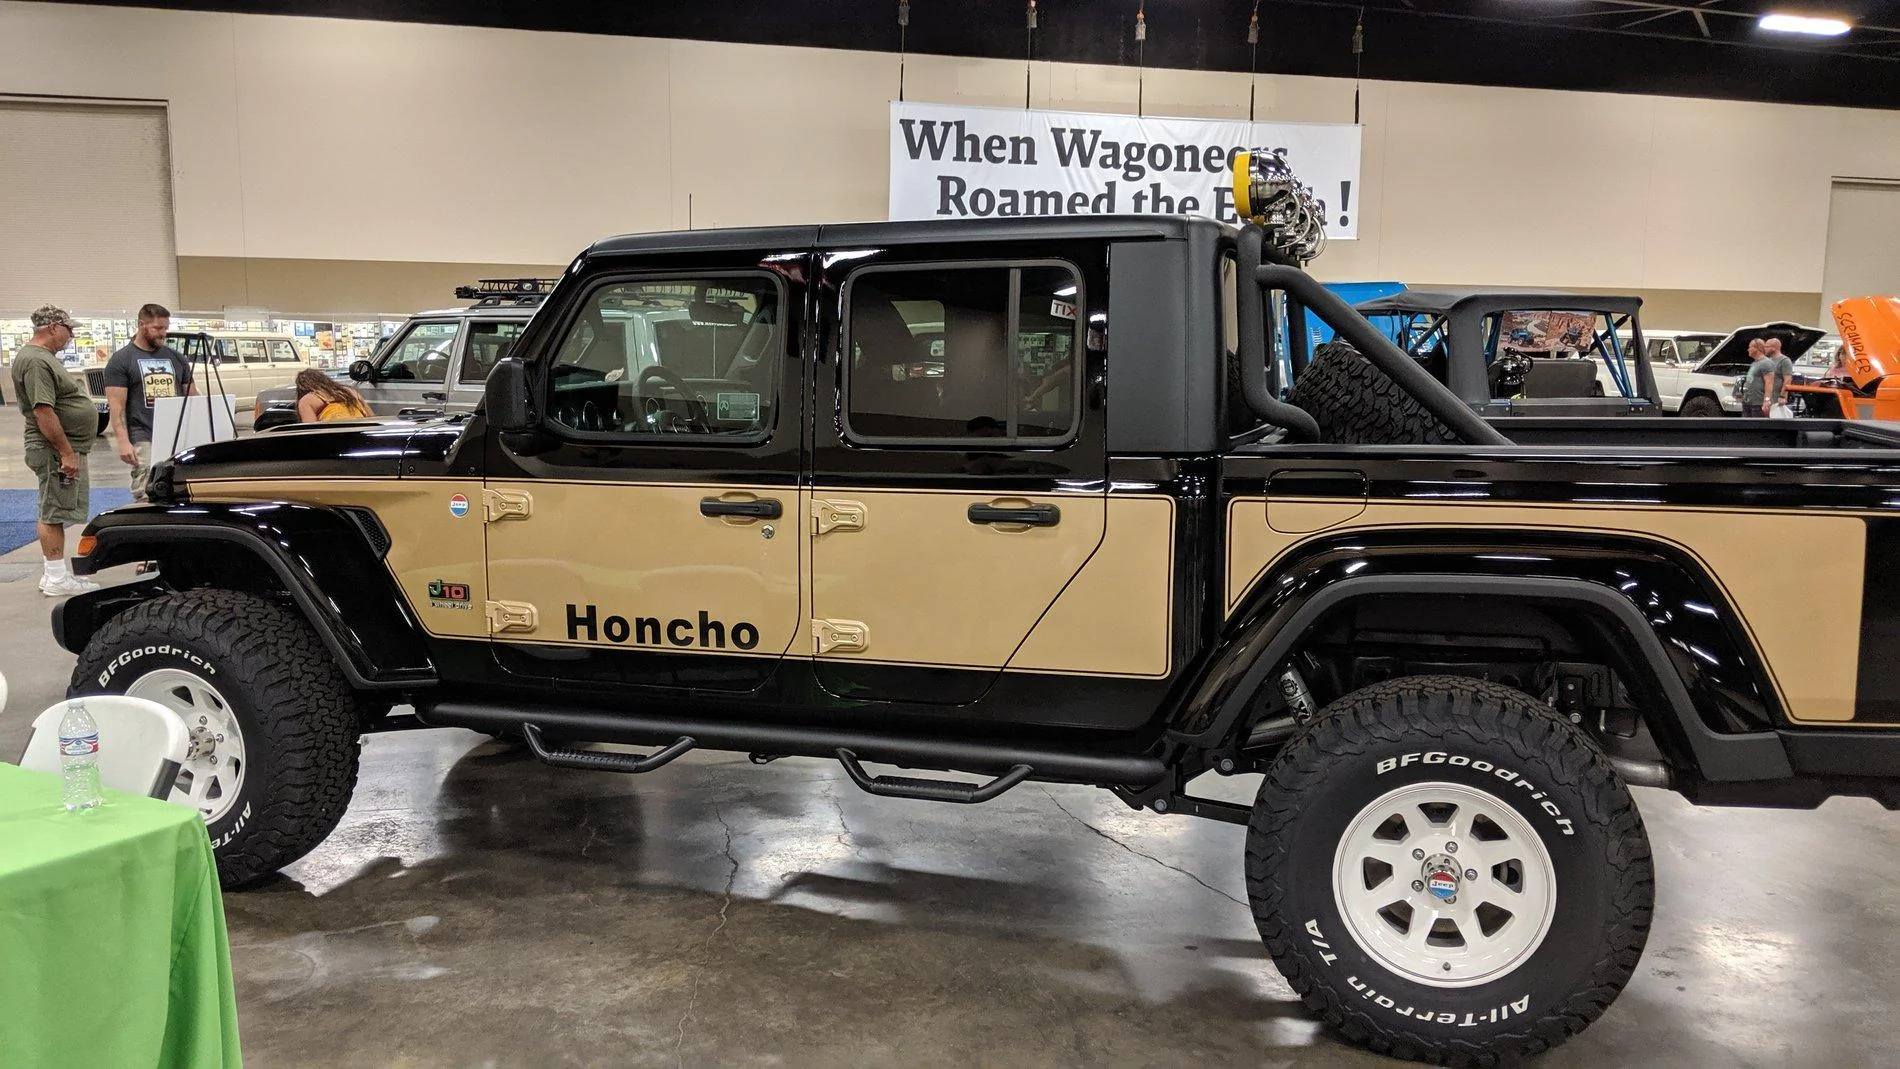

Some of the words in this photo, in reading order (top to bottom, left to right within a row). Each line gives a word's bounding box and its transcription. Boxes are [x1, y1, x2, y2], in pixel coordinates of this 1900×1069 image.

[899, 118, 1038, 165] When
[1050, 126, 1289, 182] Wagone
[936, 175, 1117, 217] Roamed
[1132, 183, 1200, 220] the
[146, 375, 173, 386] Jeep
[428, 578, 465, 599] J10
[566, 604, 760, 650] Honcho
[98, 644, 216, 688] BFGoodrich
[1376, 750, 1576, 837] BFGoodrich
[211, 801, 251, 849] All-Te
[1431, 880, 1454, 889] Jeep
[1304, 918, 1338, 967] T/A
[1347, 974, 1531, 1028] All-Terrain
